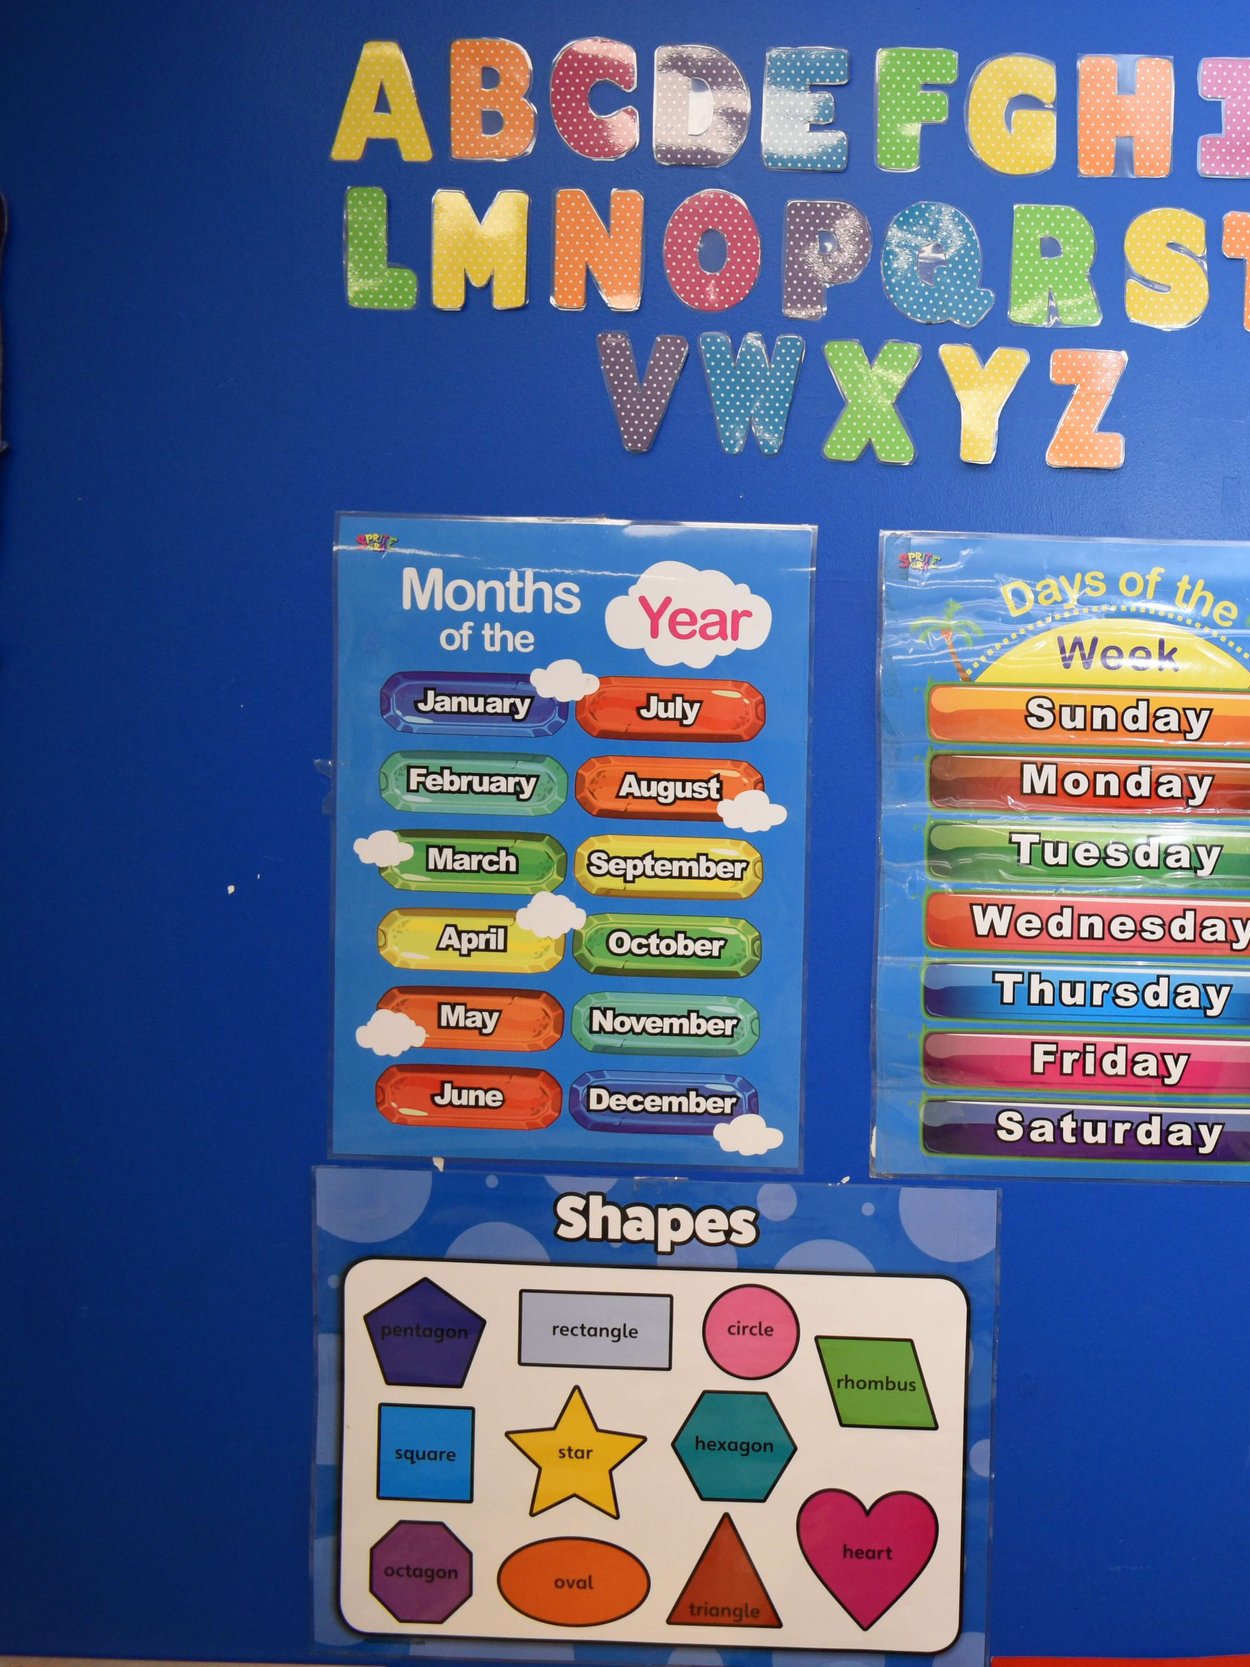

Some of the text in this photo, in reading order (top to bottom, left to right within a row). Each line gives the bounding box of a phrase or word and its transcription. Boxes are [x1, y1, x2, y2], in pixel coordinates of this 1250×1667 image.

[330, 41, 433, 161] A
[450, 38, 535, 160] B
[551, 38, 639, 160] C
[653, 44, 751, 166] D
[763, 47, 849, 171] E
[875, 47, 958, 171] F
[967, 54, 1056, 175] G
[1077, 54, 1174, 177] H
[345, 186, 417, 309] L
[432, 189, 530, 310] M
[552, 189, 644, 311] N
[664, 189, 760, 311] O
[783, 200, 872, 320] P
[881, 202, 995, 327] Q
[1008, 204, 1102, 327] R
[1124, 208, 1209, 331] S
[598, 332, 1127, 469] V W X Y Z
[402, 567, 582, 615] Months
[1000, 567, 1238, 627] Days of the
[638, 595, 753, 641] Year
[439, 621, 535, 653] of the
[1057, 635, 1179, 672] Week
[416, 689, 533, 719] January
[639, 695, 700, 725] July
[1026, 697, 1212, 740] Sunday
[407, 767, 538, 799] February
[616, 772, 722, 806] August
[1022, 760, 1216, 806] Monday
[426, 845, 519, 874] March
[587, 848, 749, 883] September
[1011, 830, 1224, 876] Tuesday
[436, 924, 507, 957] April
[606, 929, 727, 959] October
[994, 969, 1233, 1017] Thursday
[438, 1002, 502, 1036] May
[590, 1005, 740, 1038] November
[1033, 1040, 1192, 1085] Friday
[432, 1081, 505, 1109] June
[587, 1083, 739, 1116] December
[996, 1107, 1225, 1154] Saturday
[556, 1195, 757, 1252] Shapes
[381, 1324, 468, 1343] pentagon
[552, 1322, 639, 1343] rectangle
[727, 1320, 774, 1337] circle
[836, 1373, 917, 1392] rhombus
[395, 1448, 456, 1465] square
[558, 1445, 594, 1460] star
[695, 1435, 774, 1457] hexagon
[843, 1543, 893, 1561] heart
[384, 1565, 458, 1584] octagon
[554, 1575, 593, 1590] oval
[689, 1602, 761, 1623] triangle
